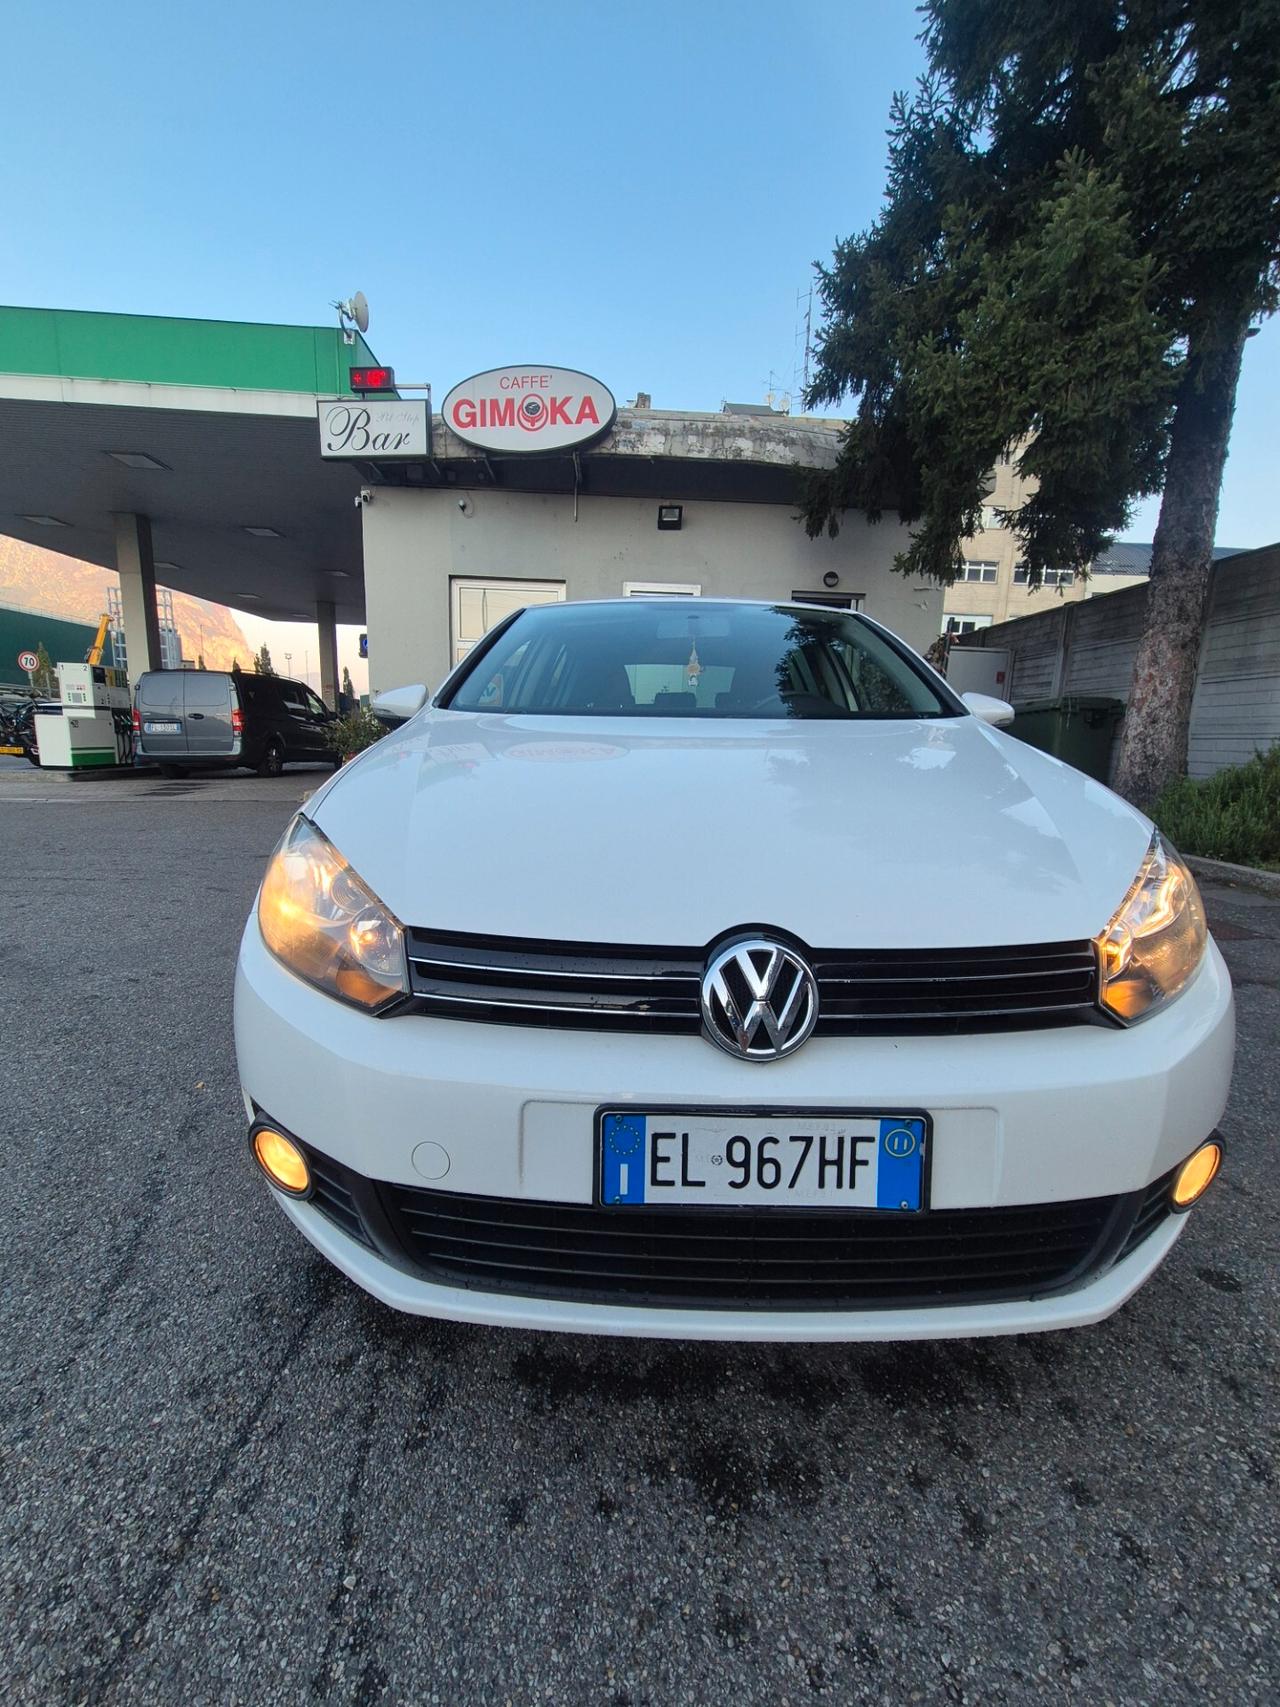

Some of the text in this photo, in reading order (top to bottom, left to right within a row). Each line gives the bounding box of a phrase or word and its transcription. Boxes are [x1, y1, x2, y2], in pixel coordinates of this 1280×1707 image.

[325, 405, 411, 452] Bar
[452, 393, 601, 432] GIMOKA
[23, 657, 35, 667] 70
[650, 1132, 876, 1190] EL 967HF
